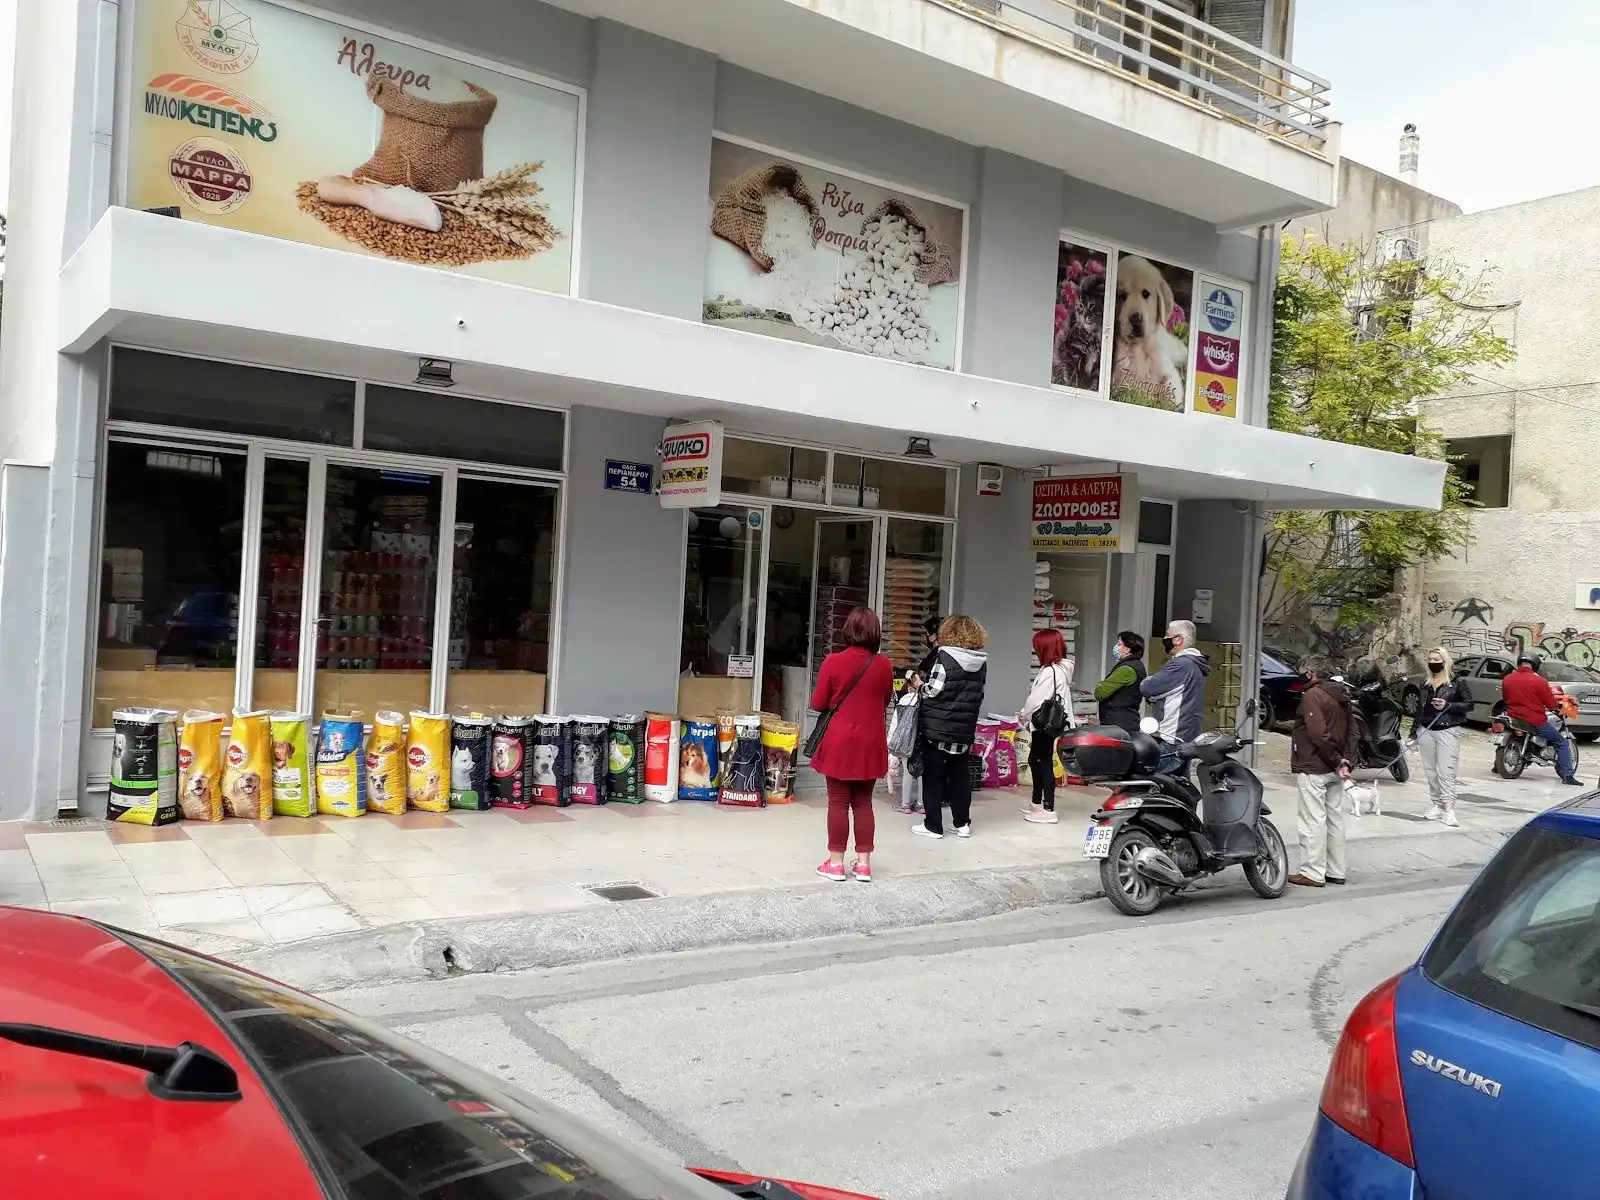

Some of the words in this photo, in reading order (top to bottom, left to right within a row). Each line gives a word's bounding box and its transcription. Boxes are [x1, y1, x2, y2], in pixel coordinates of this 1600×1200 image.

[181, 35, 240, 71] ΠΑΠΑΦΙΛΗ
[201, 40, 235, 55] ΜΥΛΟΙ
[196, 154, 228, 167] ΜΥΛΟΙ
[822, 182, 865, 217] Ρύζια
[1205, 302, 1235, 320] Farmina
[1198, 386, 1233, 403] Pedigree
[608, 467, 650, 479] ΠΕΡΙΑΝΔΡΟΥ
[620, 475, 638, 487] 54
[1035, 484, 1070, 497] ΟΣΠΡΙΑ
[1072, 483, 1079, 496] &
[1080, 481, 1119, 496] ΑΛΕΥΡΑ
[1034, 501, 1118, 518] ΖΩΟΤΡΟΦΕΣ
[722, 790, 757, 802] STANDARD
[1410, 1049, 1502, 1098] SUZUKI
